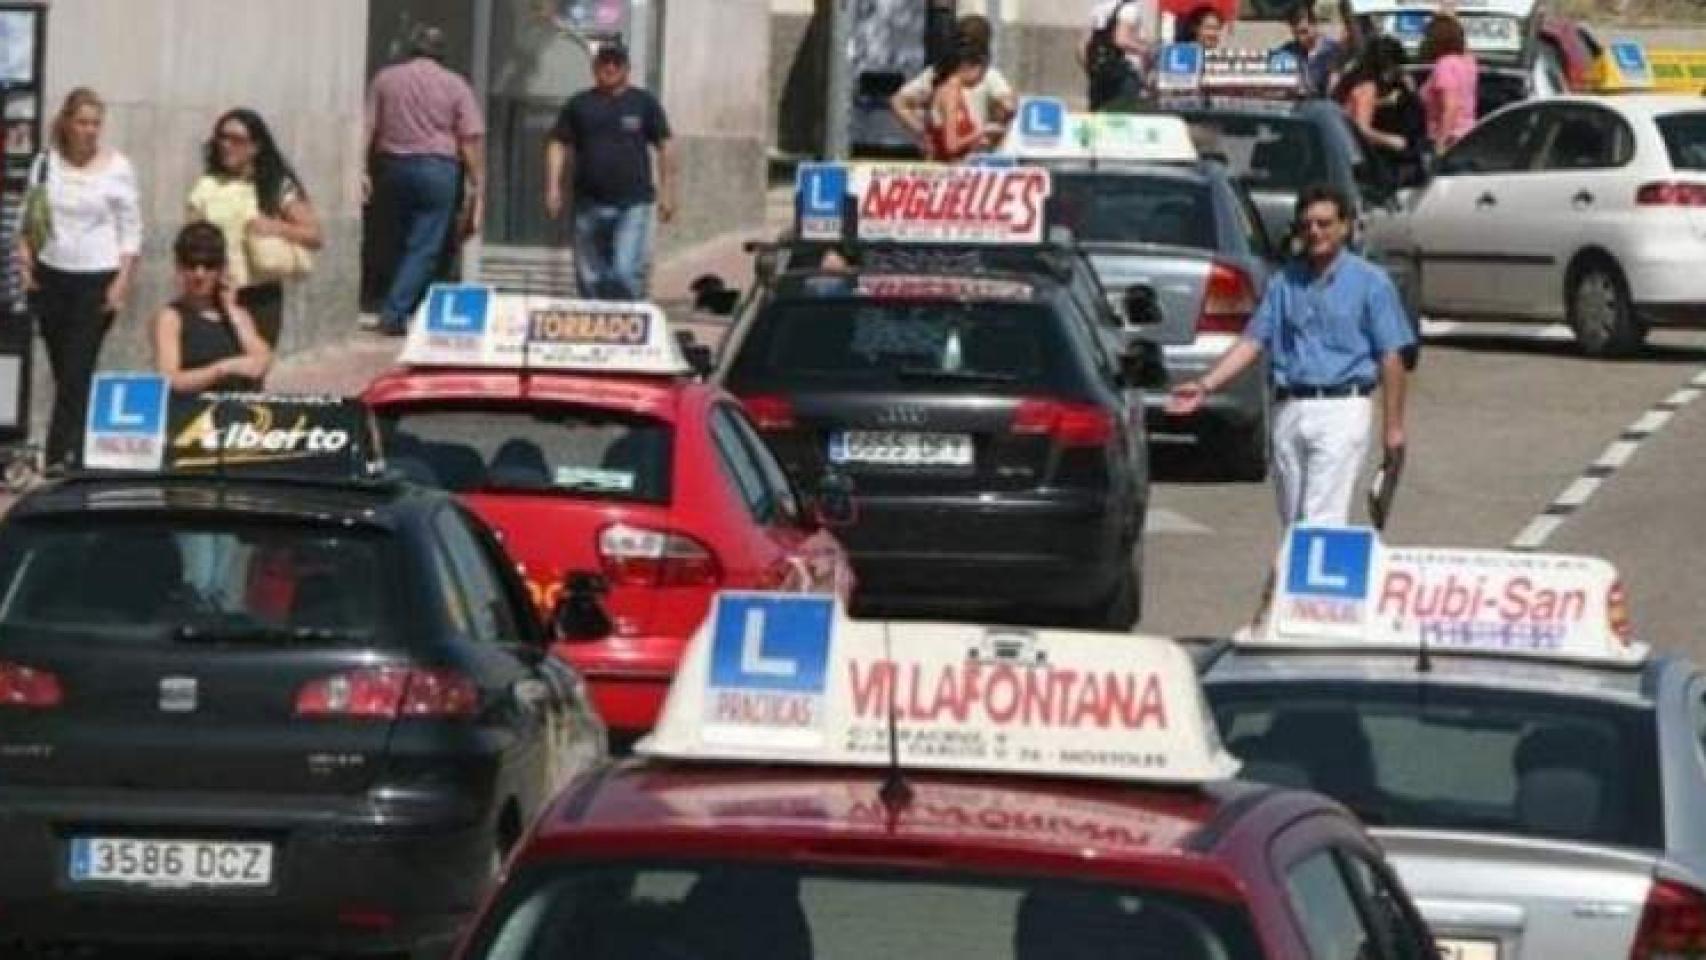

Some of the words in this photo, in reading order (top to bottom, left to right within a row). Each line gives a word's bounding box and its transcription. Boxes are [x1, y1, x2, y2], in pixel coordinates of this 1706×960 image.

[1170, 49, 1188, 73] L
[1619, 47, 1638, 65] L
[1030, 105, 1053, 131] L
[811, 175, 836, 209] L
[440, 293, 471, 325] L
[535, 313, 641, 341] TORRADO
[108, 383, 145, 424] L
[174, 403, 349, 451] Alberto
[1307, 535, 1348, 587] L
[1376, 569, 1586, 623] Rubi-San
[741, 607, 797, 675] L
[849, 658, 1168, 729] VILLAFONTANA
[96, 843, 184, 877] 3586
[195, 845, 262, 879] DCZ
